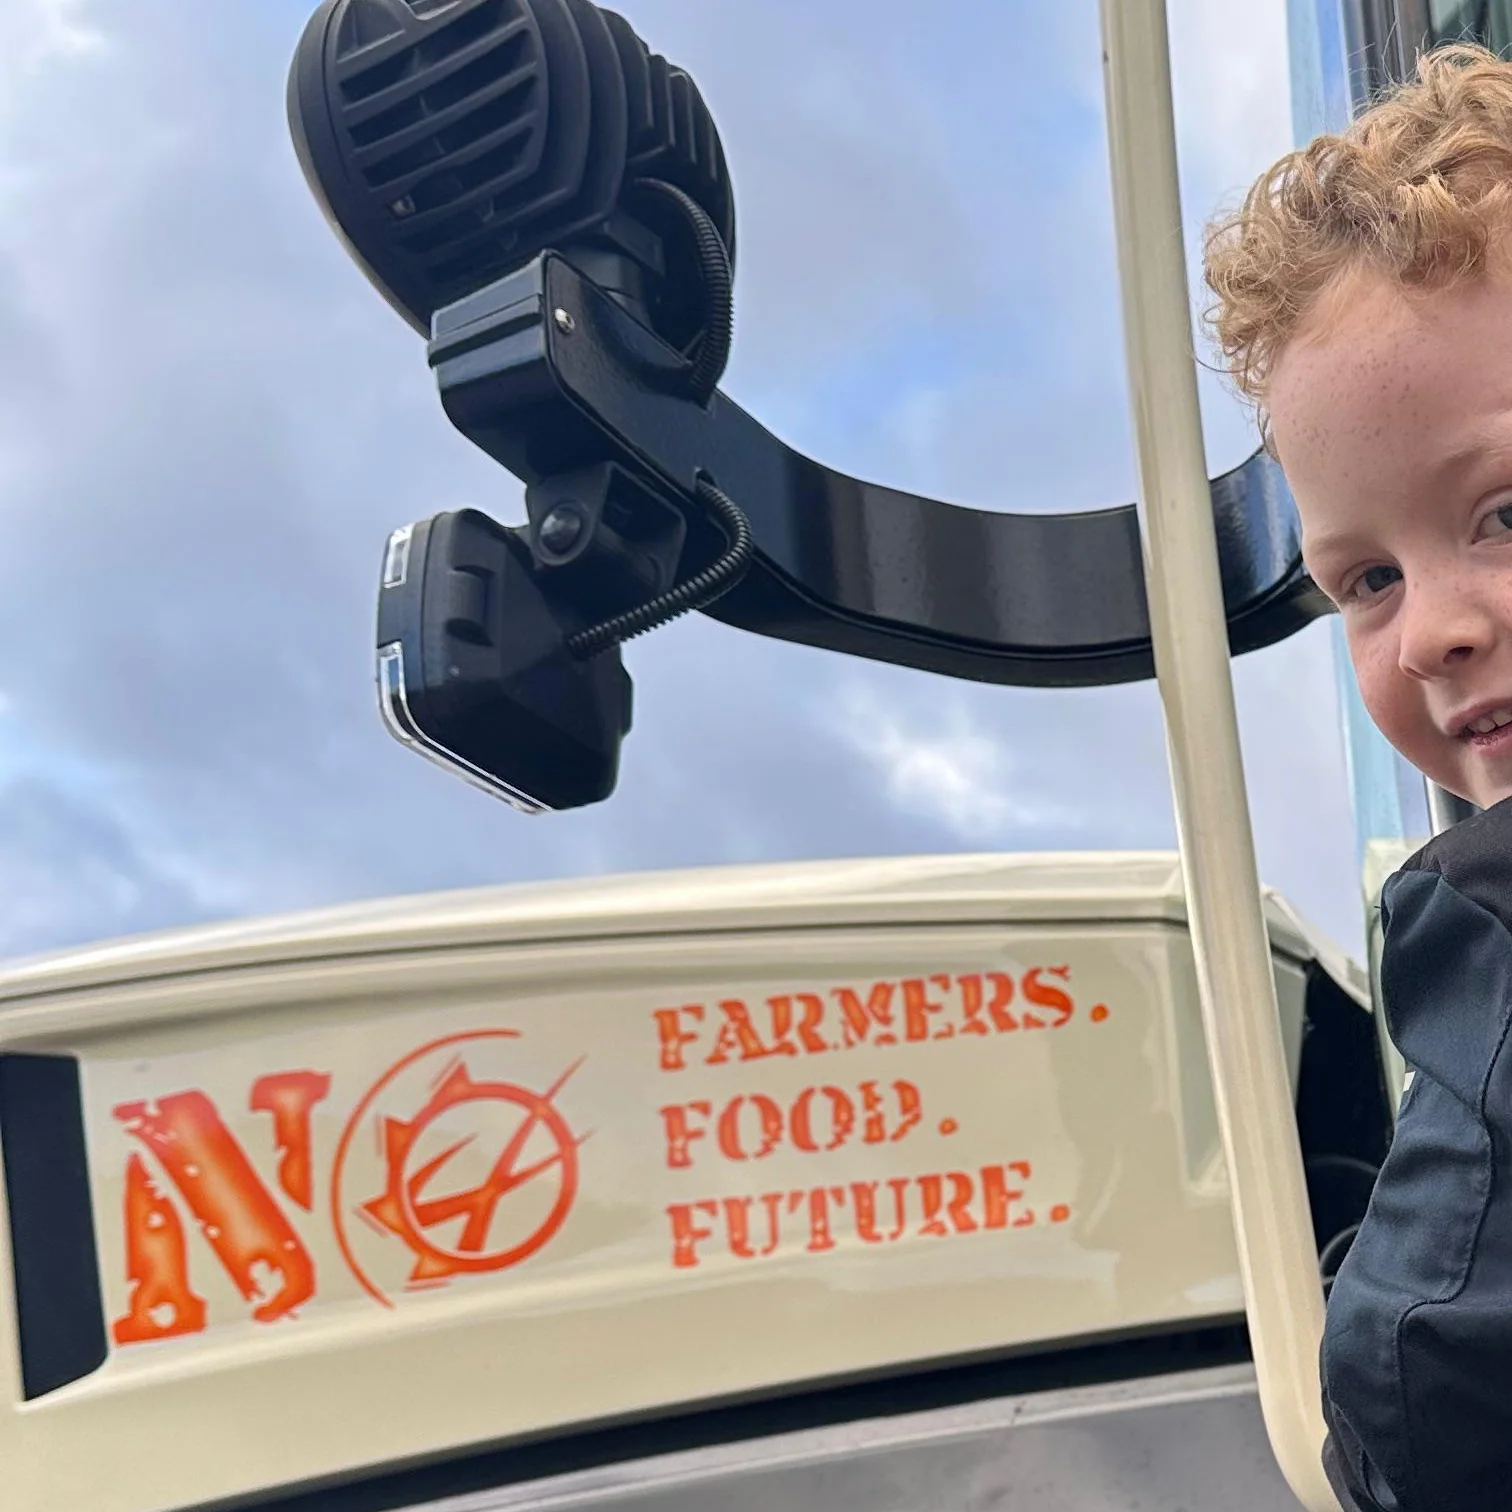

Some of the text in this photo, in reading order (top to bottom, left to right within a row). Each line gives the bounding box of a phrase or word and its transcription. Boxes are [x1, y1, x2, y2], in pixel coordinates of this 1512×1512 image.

[652, 965, 1109, 1071] FARMERS.
[660, 1079, 958, 1169] FOOD.
[665, 1161, 1071, 1268] FUTURE.
